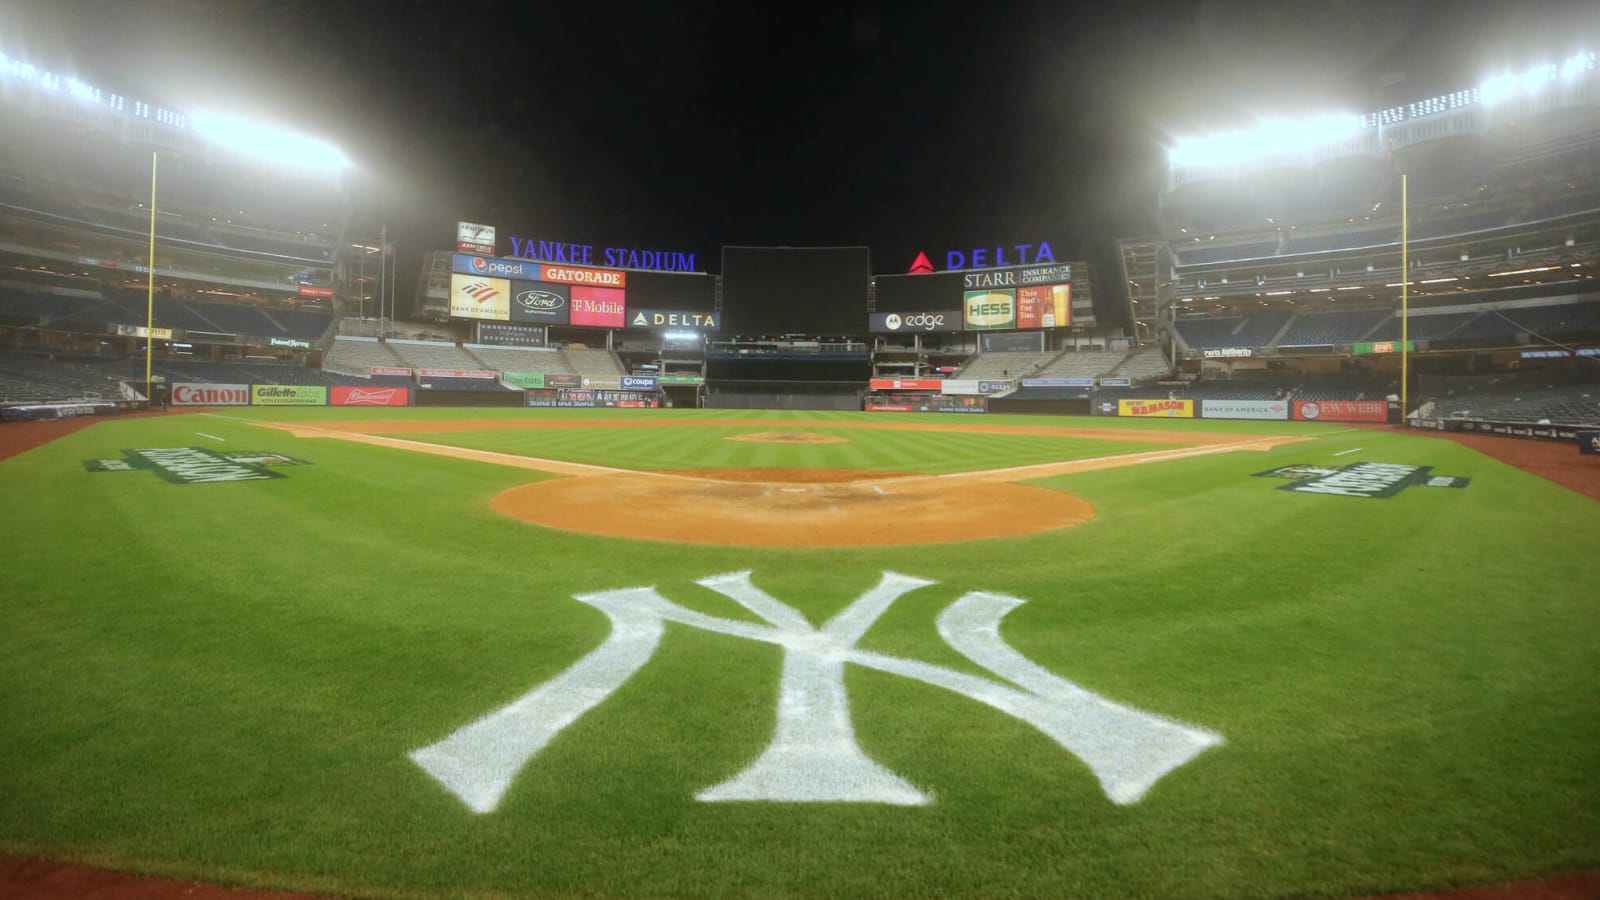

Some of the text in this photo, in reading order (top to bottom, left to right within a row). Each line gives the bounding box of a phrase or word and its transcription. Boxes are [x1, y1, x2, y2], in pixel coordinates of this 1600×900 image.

[509, 236, 696, 273] YANKEE STADIUM
[947, 241, 1056, 271] DELTA
[488, 262, 523, 276] pepsi
[547, 268, 620, 285] GATORADE
[965, 265, 1072, 288] STARR INSURANCE
[524, 292, 556, 308] Ford
[1020, 289, 1038, 297] This
[452, 304, 509, 316] BANK OF AMERICA
[969, 302, 1011, 317] HESS
[1020, 304, 1033, 313] For
[653, 312, 715, 327] DELTA
[905, 312, 945, 330] edge
[632, 378, 654, 387] coupa
[173, 385, 248, 403] Canon
[1345, 402, 1383, 414] WEBB
[409, 569, 1225, 815] NY
